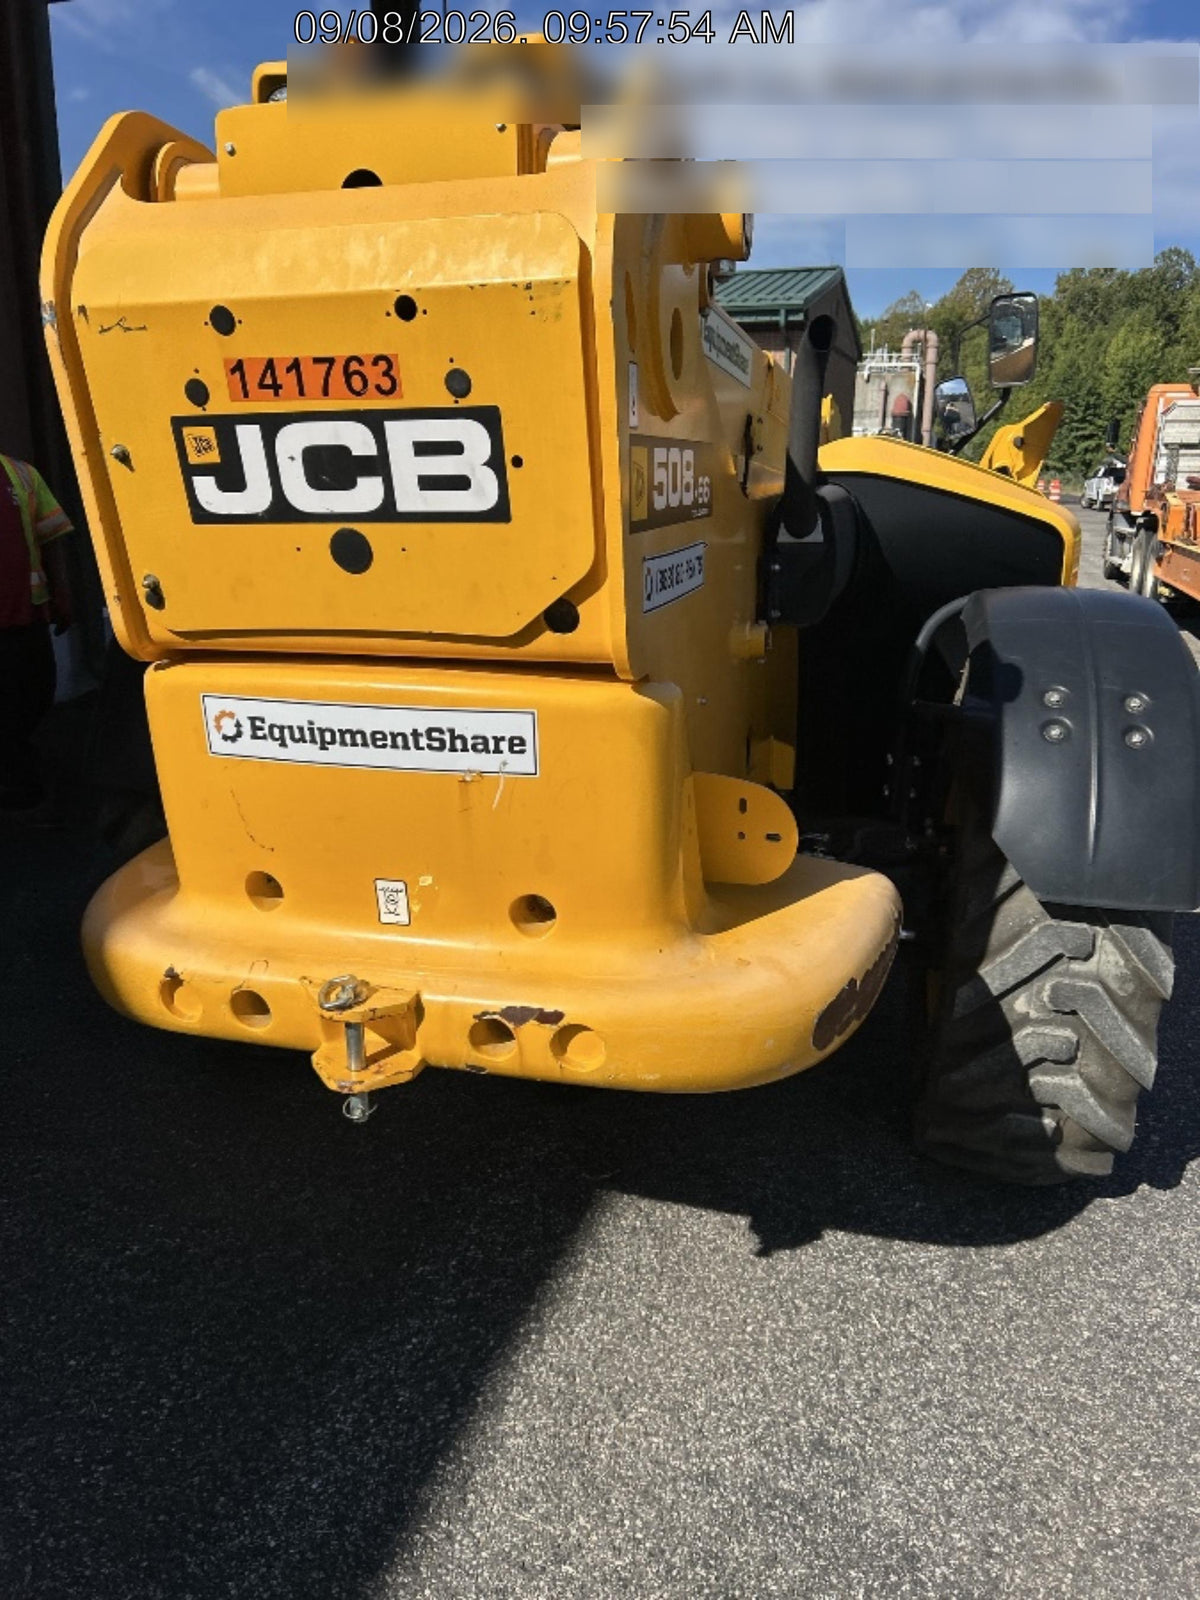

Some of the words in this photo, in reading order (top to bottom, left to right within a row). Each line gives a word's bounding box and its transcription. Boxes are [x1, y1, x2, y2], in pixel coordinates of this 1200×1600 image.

[229, 354, 398, 399] 141763
[192, 418, 499, 514] JCB
[247, 715, 527, 755] EquipmentShare
